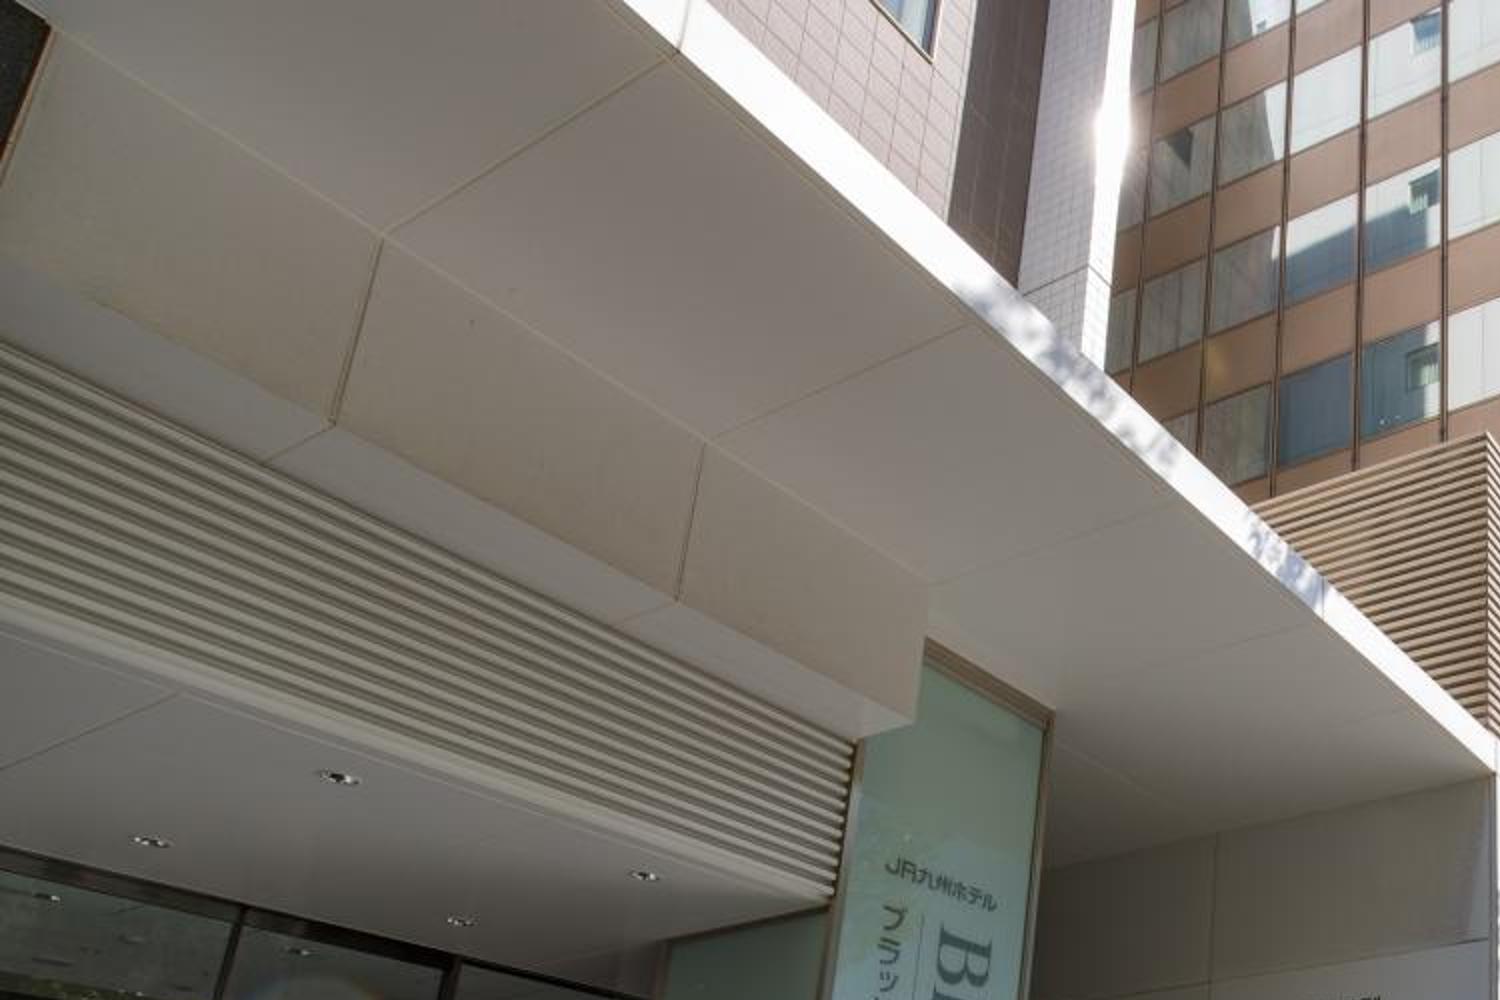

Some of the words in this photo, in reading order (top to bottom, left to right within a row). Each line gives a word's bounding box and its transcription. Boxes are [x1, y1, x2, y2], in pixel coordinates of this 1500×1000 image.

[884, 855, 999, 913] JR九州ホテル
